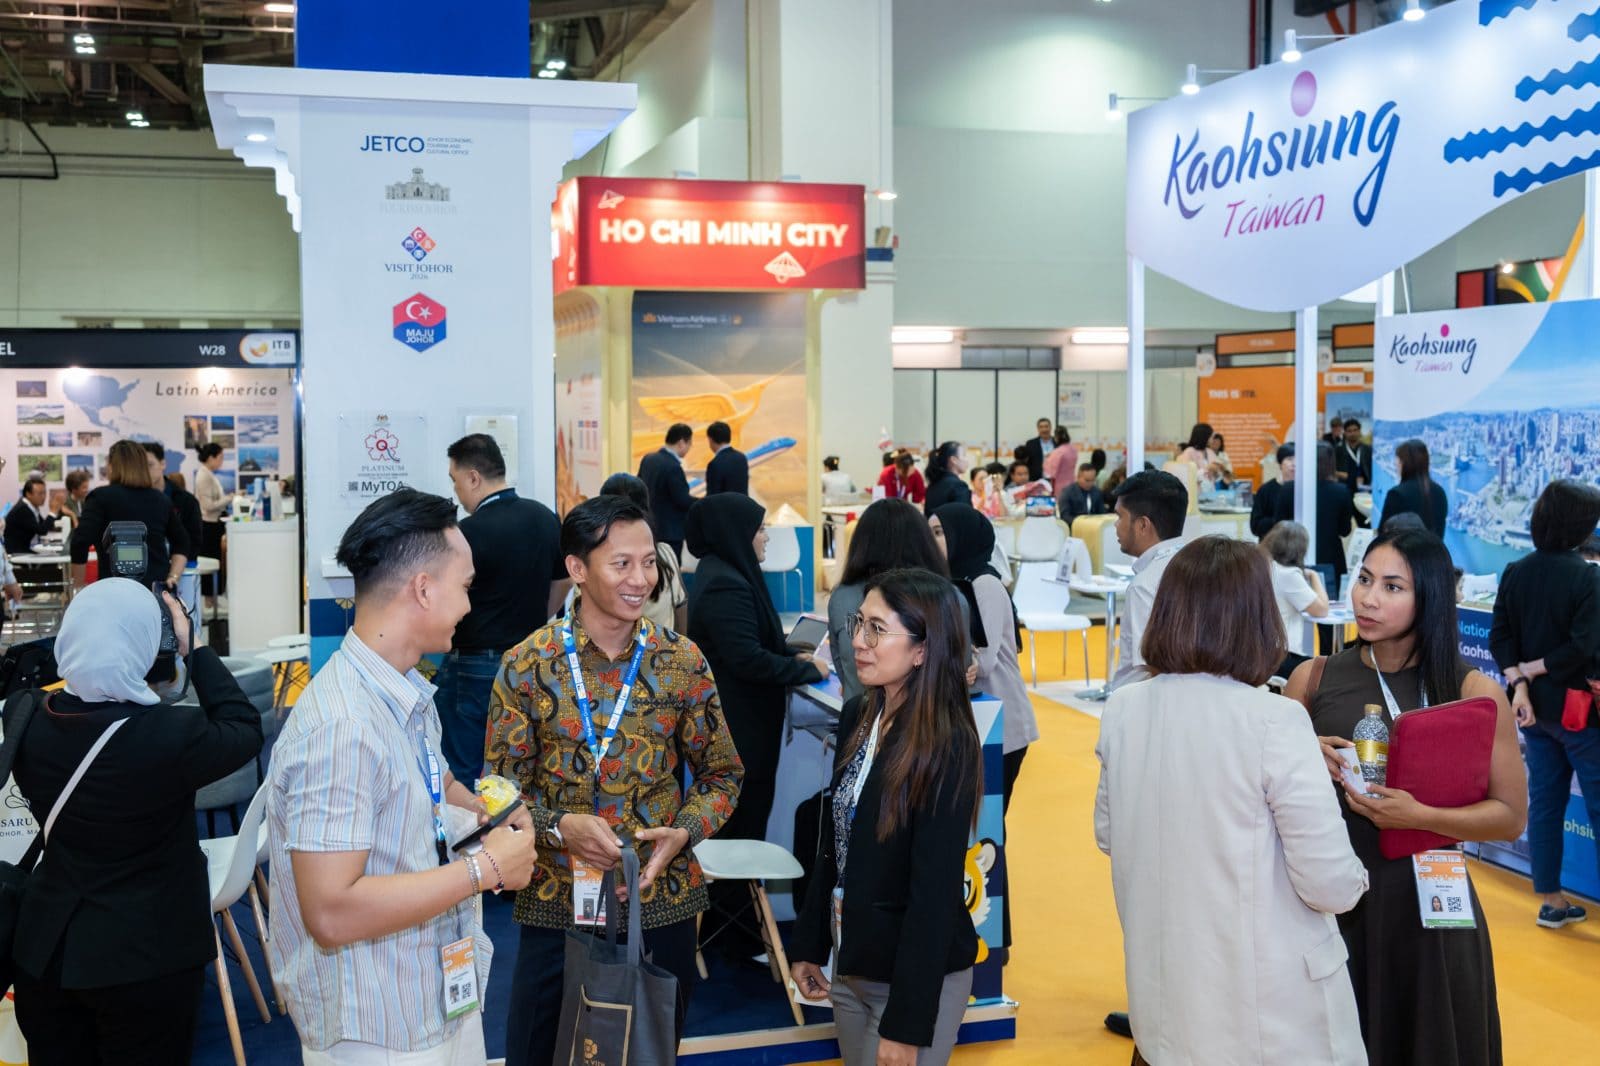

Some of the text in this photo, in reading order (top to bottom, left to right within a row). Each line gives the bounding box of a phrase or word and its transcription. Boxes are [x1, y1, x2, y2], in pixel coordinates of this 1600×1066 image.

[360, 135, 425, 153] JETCO
[1164, 70, 1401, 227] Kaohsiung
[1224, 194, 1325, 238] Taiwan
[600, 219, 848, 248] HO CHI MINH CITY
[384, 263, 453, 273] VISIT JOHOR
[406, 328, 434, 337] MAJU
[406, 336, 434, 344] JOHOR
[199, 345, 226, 356] W28
[273, 340, 290, 349] ITB
[1389, 323, 1477, 374] Kaohsiung
[155, 381, 278, 396] Latin America
